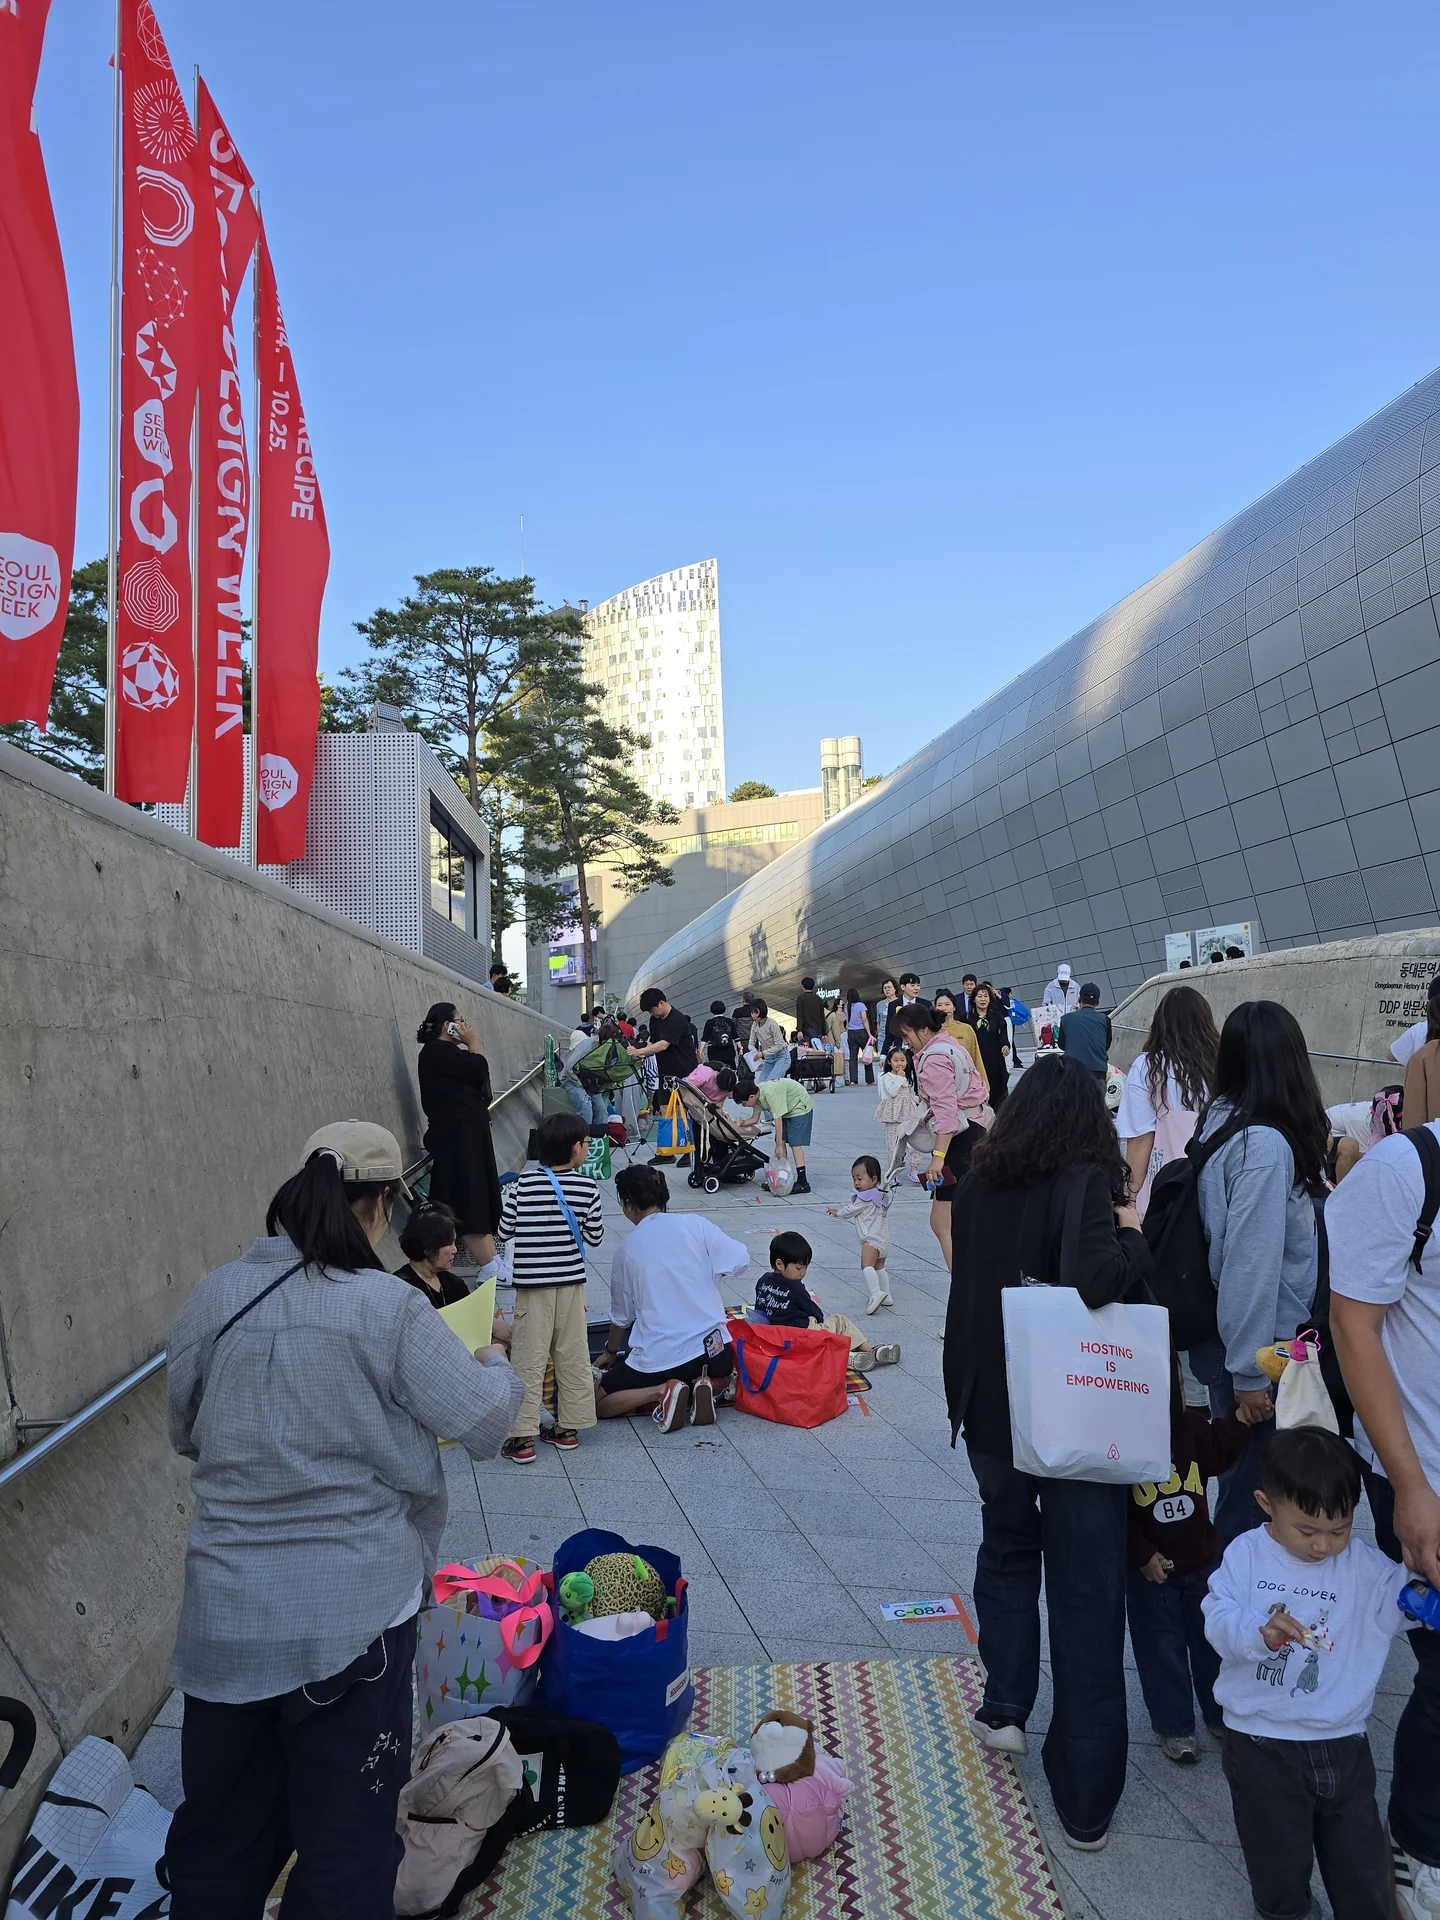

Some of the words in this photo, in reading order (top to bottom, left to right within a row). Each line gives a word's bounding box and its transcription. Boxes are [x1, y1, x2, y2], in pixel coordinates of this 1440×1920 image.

[269, 390, 290, 452] 10.25.
[826, 988, 841, 999] Lounge
[1379, 1000, 1401, 1014] DDP
[1080, 1341, 1133, 1359] HOSTING
[1105, 1360, 1117, 1373] IS
[1065, 1373, 1150, 1395] EMPOWERING
[1163, 1499, 1186, 1519] 84
[1257, 1580, 1286, 1592] DOG
[1293, 1586, 1337, 1603] LOVER
[893, 1606, 947, 1617] C-084
